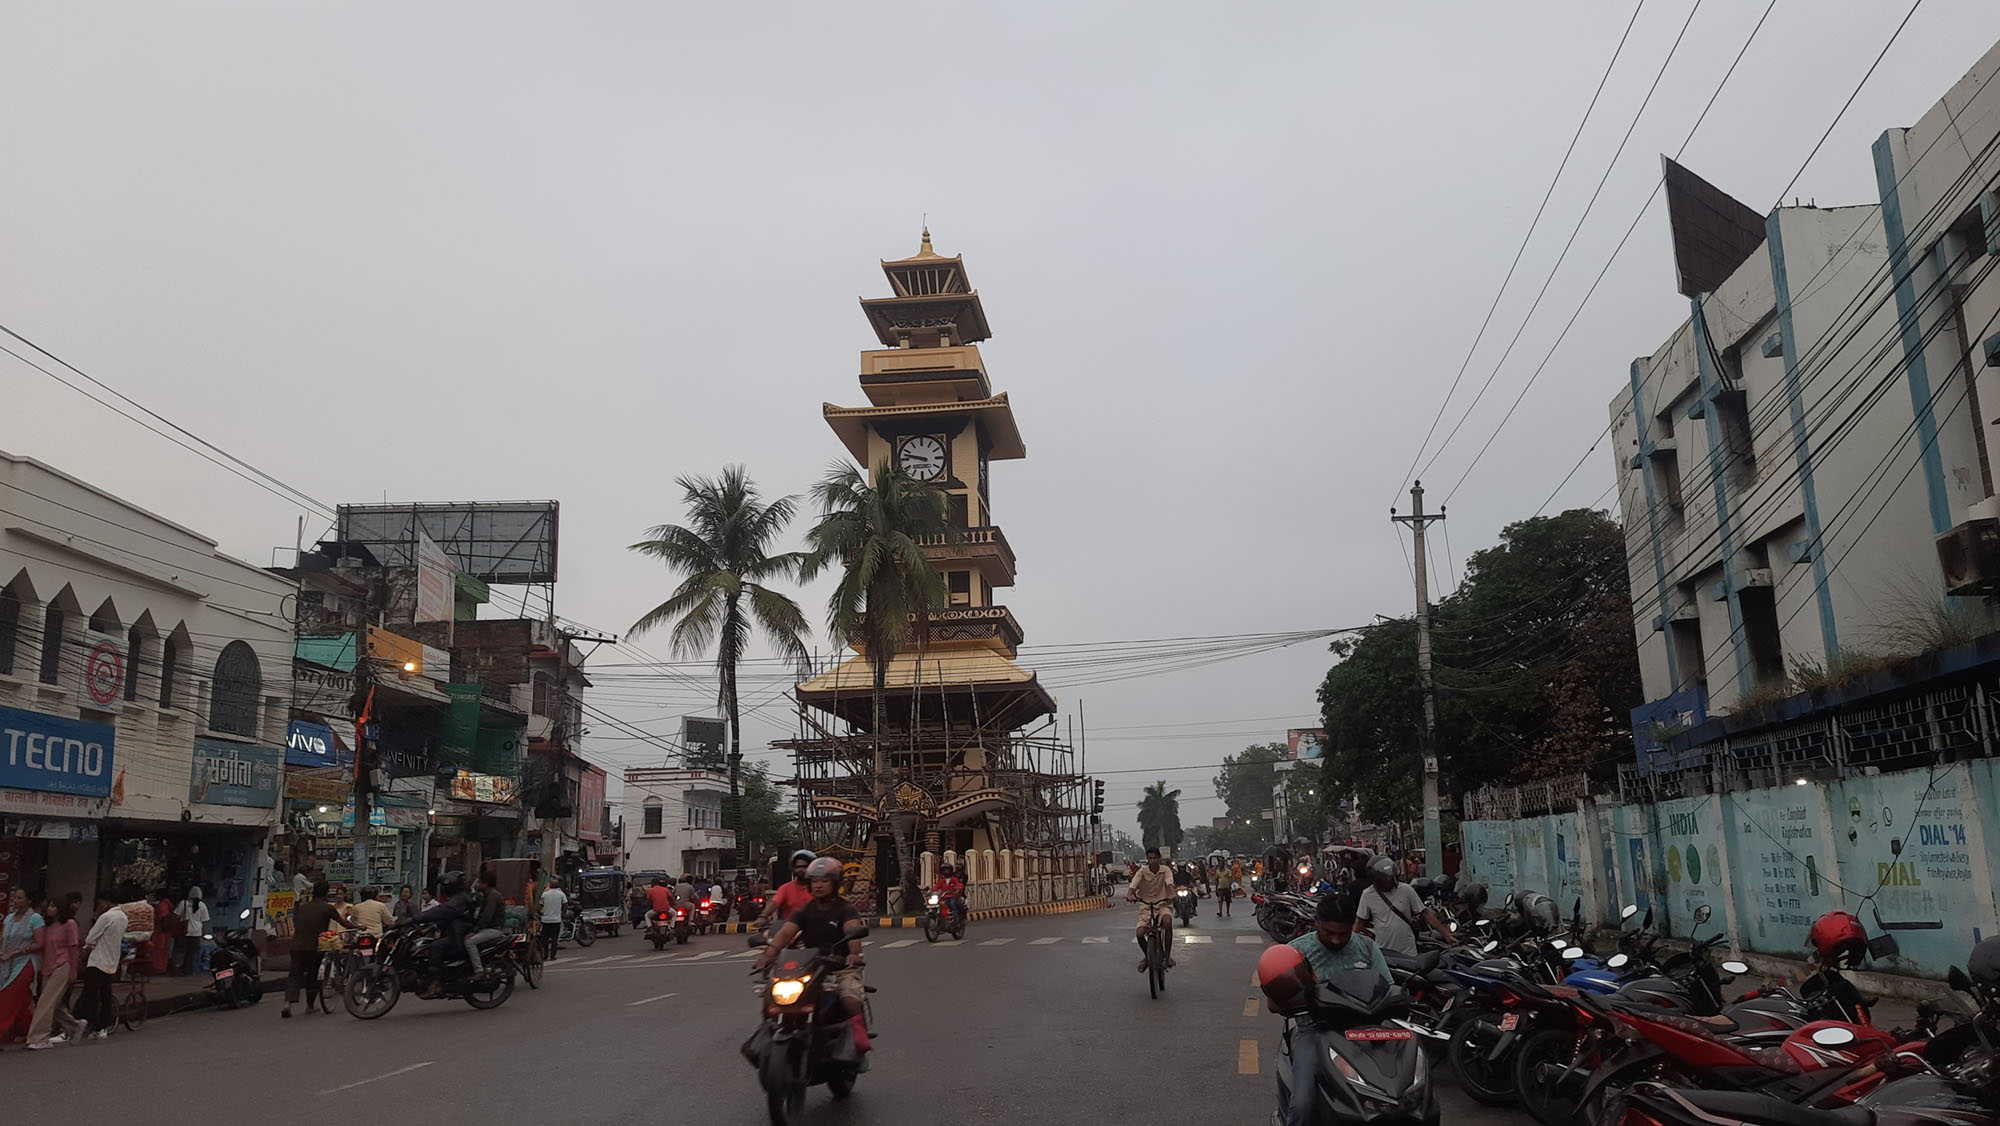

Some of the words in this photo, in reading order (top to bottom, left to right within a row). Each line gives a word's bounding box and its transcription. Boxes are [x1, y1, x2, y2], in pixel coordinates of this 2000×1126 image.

[4, 728, 104, 777] TECNO
[286, 728, 326, 755] vivo
[1670, 811, 1699, 836] INDIA
[1920, 824, 1949, 846] DIAL
[1878, 862, 1921, 886] DIAL
